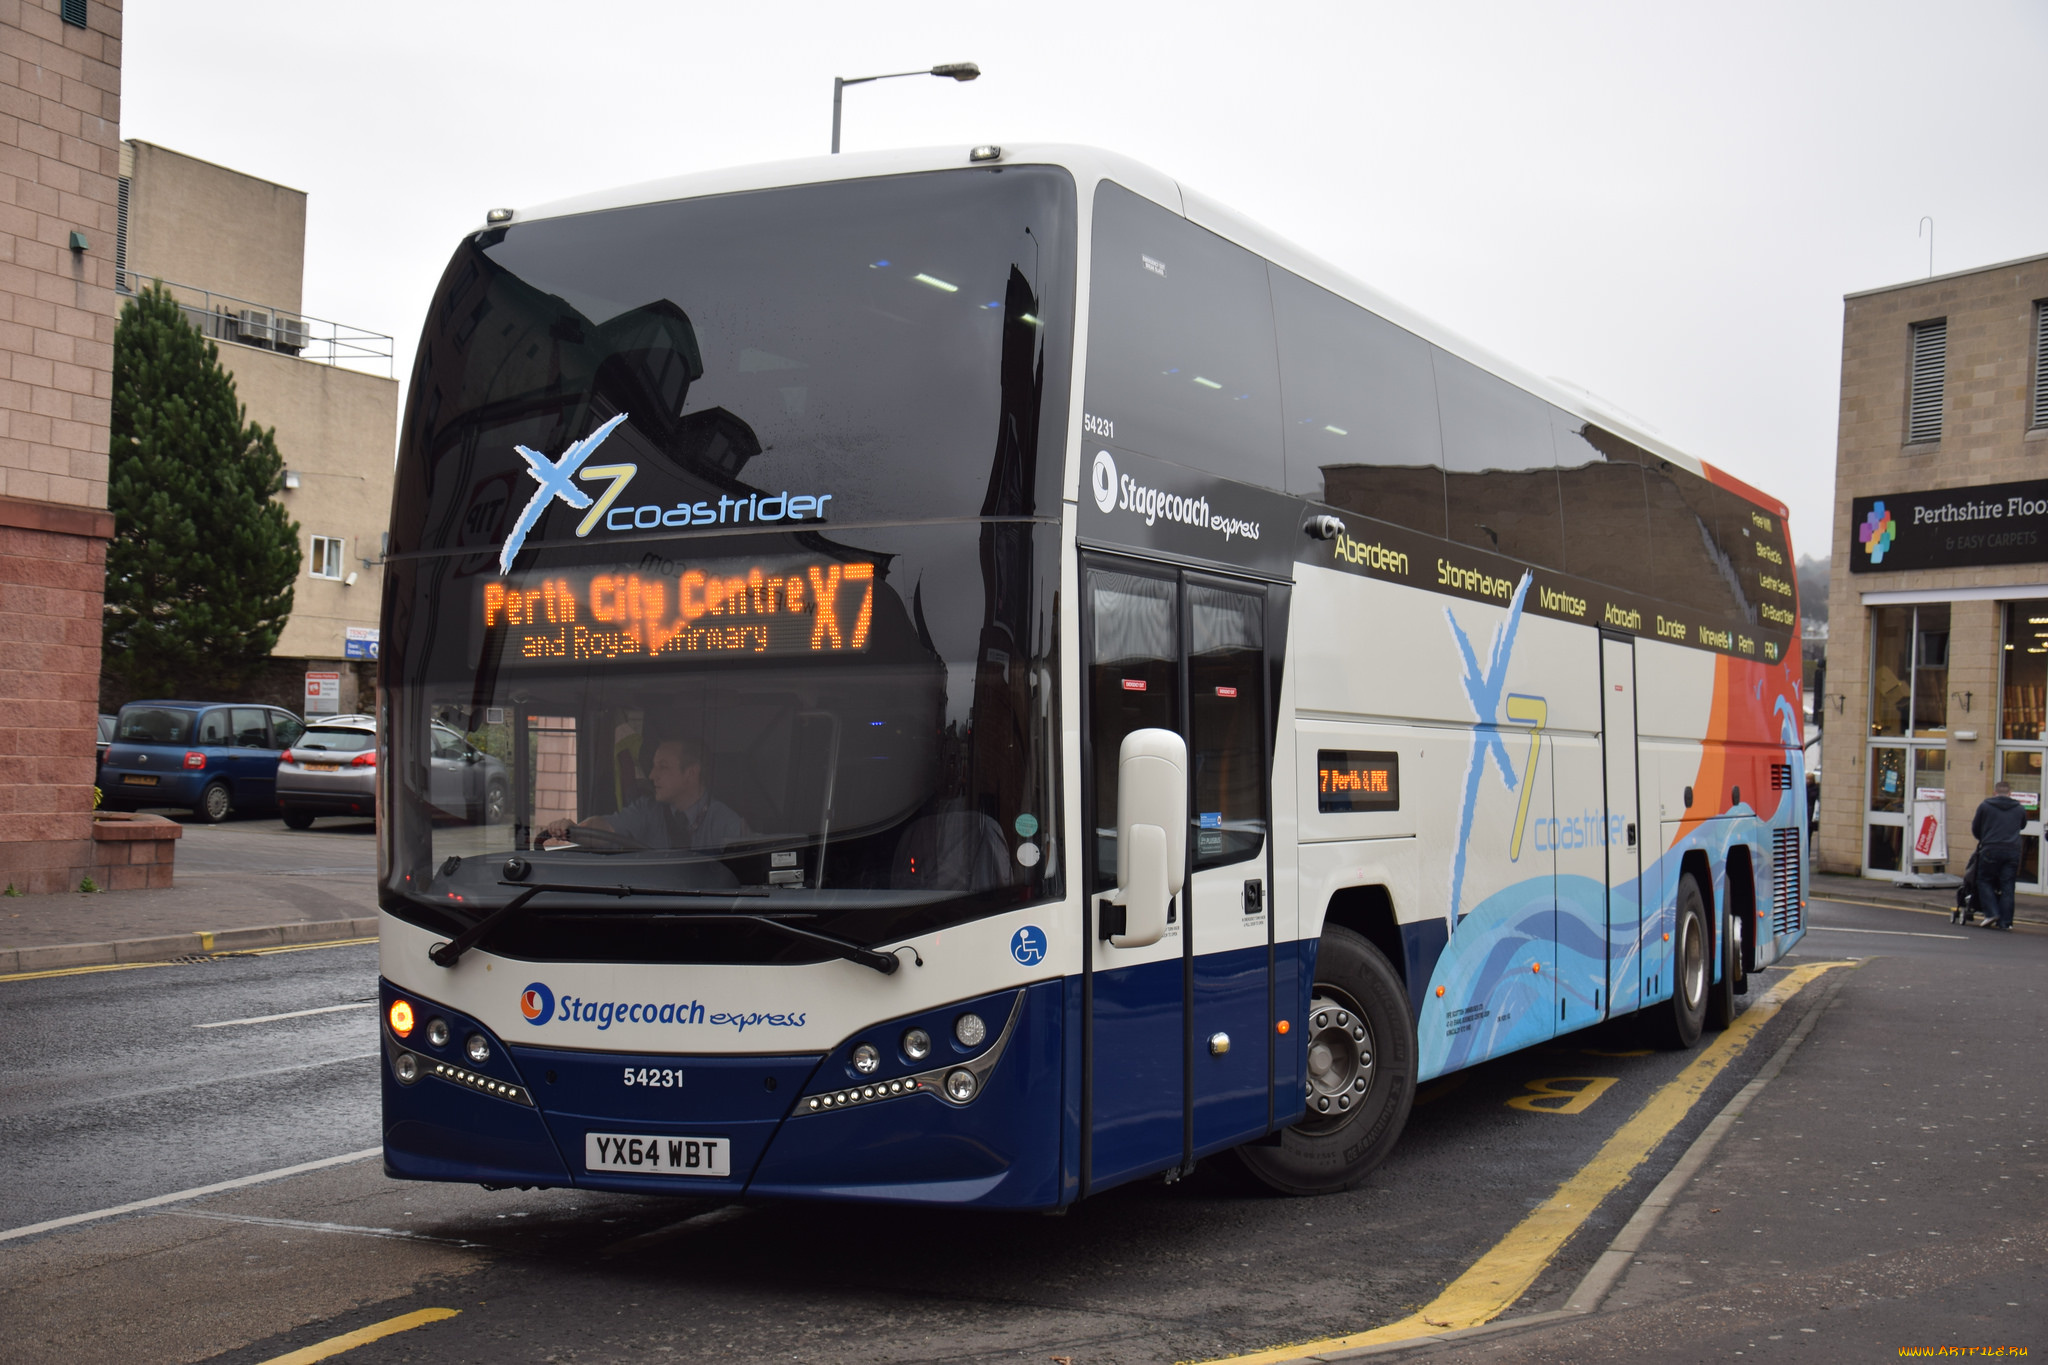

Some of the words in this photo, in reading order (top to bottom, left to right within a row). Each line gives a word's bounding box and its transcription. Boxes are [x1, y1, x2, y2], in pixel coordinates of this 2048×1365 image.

[1085, 413, 1115, 438] 54231
[606, 491, 833, 531] coastrider
[1119, 473, 1209, 527] Stagecoach
[1210, 514, 1260, 542] express
[1912, 500, 2003, 526] Perthshire
[2006, 496, 2048, 518] Floo
[1334, 534, 1409, 575] Aberdeen
[1957, 535, 1985, 550] EASY
[1987, 531, 2038, 548] CARPETS
[1438, 558, 1513, 600] Stonehaven
[484, 578, 576, 627] Perth
[590, 573, 665, 628] City
[680, 567, 804, 619] Centre
[809, 564, 874, 650] X7
[1540, 585, 1586, 617] Montrose
[1604, 602, 1641, 631] Arbroath
[1656, 615, 1686, 640] Dundee
[522, 627, 565, 659] and
[574, 625, 641, 659] Royal
[1699, 625, 1728, 649] Ninewells
[1738, 635, 1754, 655] Perth
[1320, 769, 1329, 792] 7
[1331, 769, 1361, 792] Perth
[1370, 769, 1388, 792] PRI
[1533, 808, 1626, 852] coastrider
[558, 995, 705, 1031] Stagecoach
[709, 1012, 806, 1033] express
[623, 1068, 684, 1088] 54231
[596, 1136, 660, 1166] YX64
[668, 1140, 718, 1169] WBT
